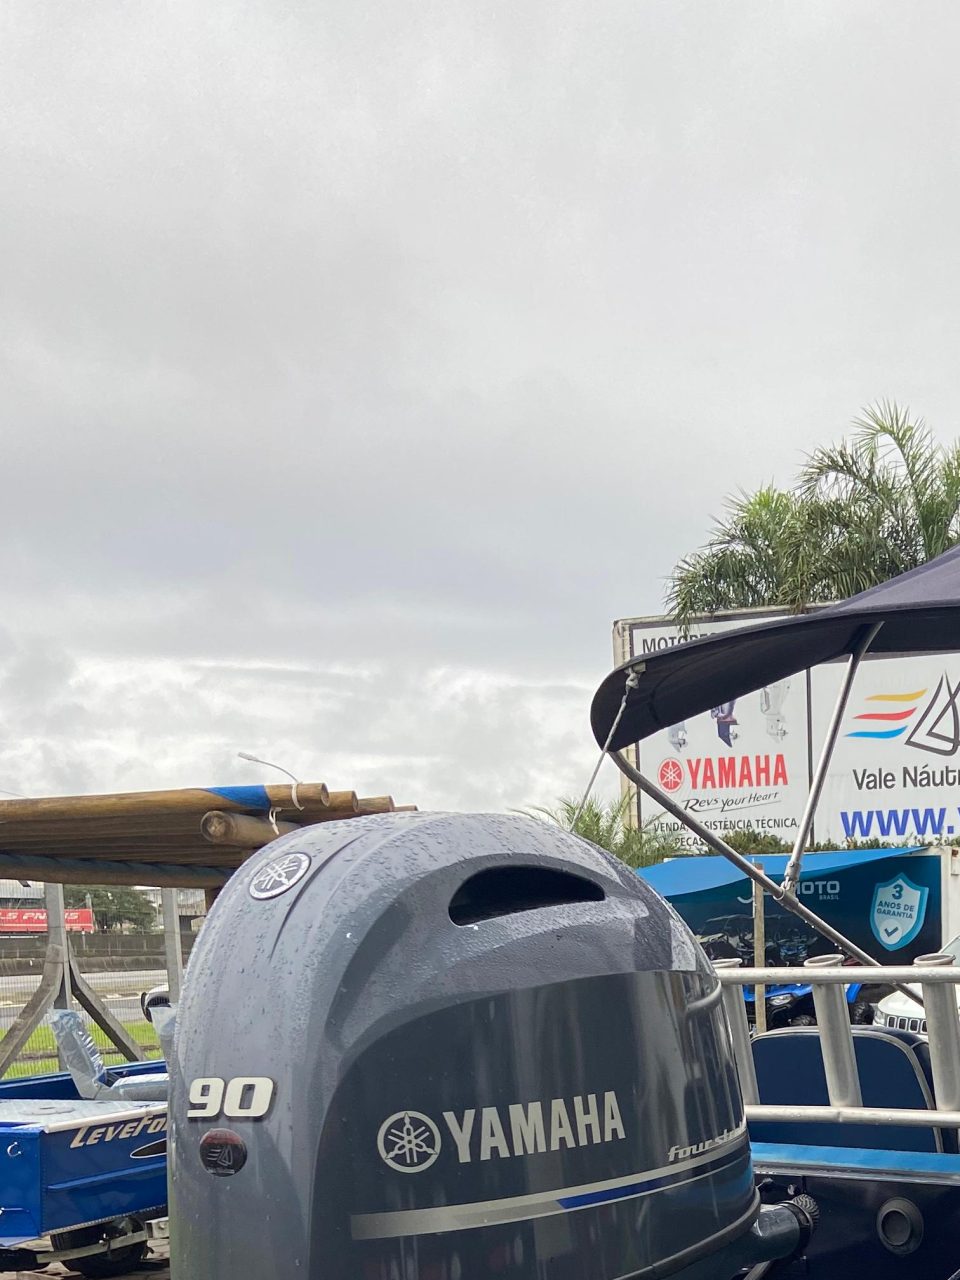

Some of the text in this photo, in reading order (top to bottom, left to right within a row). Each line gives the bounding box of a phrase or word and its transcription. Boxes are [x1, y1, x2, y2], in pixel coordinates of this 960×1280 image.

[687, 754, 788, 789] YAMAHA
[852, 768, 896, 790] Vale
[682, 792, 779, 812] Revs your Heart
[892, 884, 904, 900] 3
[876, 907, 913, 919] GARANTIA
[877, 900, 915, 913] ANOS DE
[187, 1077, 274, 1118] 90
[442, 1091, 626, 1163] YAMAHA
